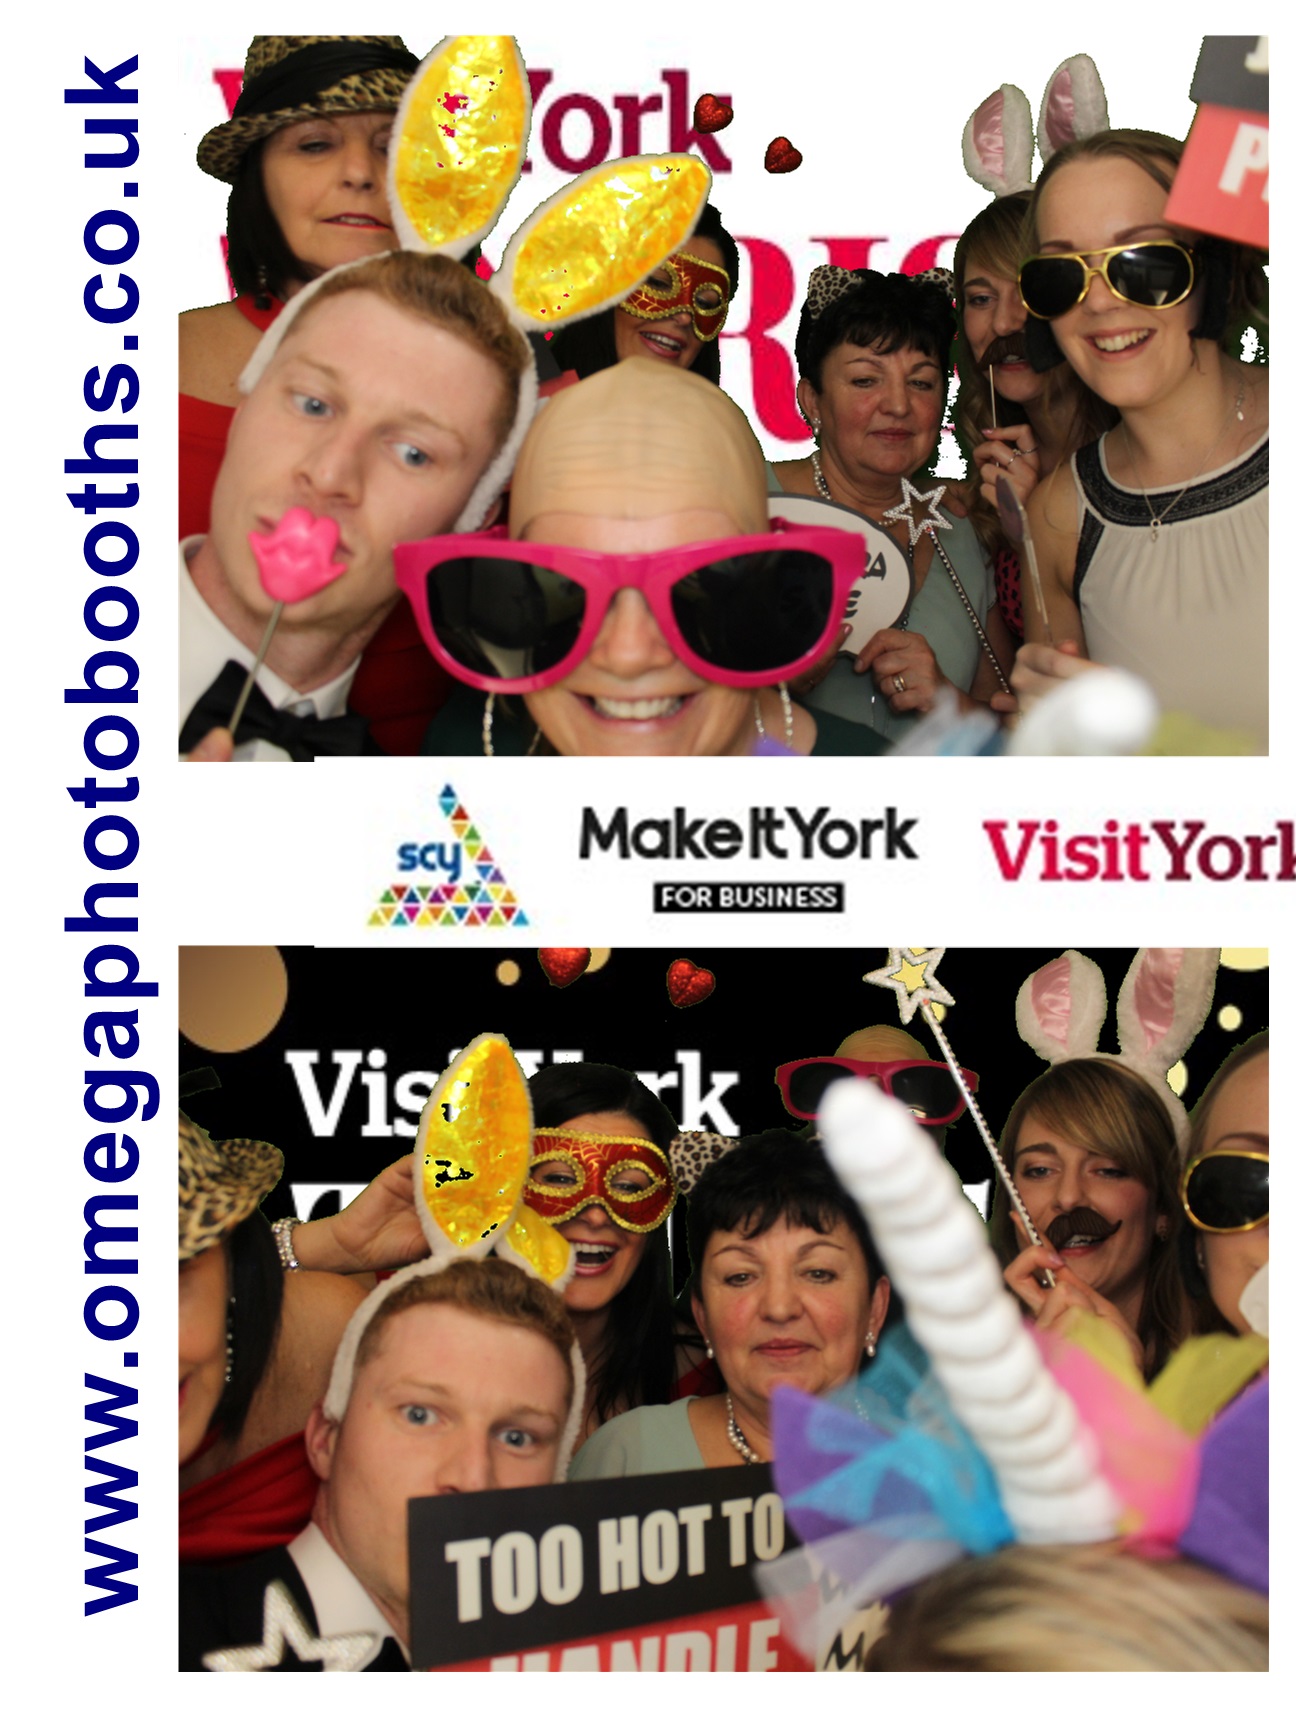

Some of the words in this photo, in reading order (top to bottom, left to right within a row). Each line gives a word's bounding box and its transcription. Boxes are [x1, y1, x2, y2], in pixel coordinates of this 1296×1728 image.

[445, 1525, 583, 1623] TOO
[599, 1504, 711, 1596] HOT
[721, 1493, 786, 1567] TO
